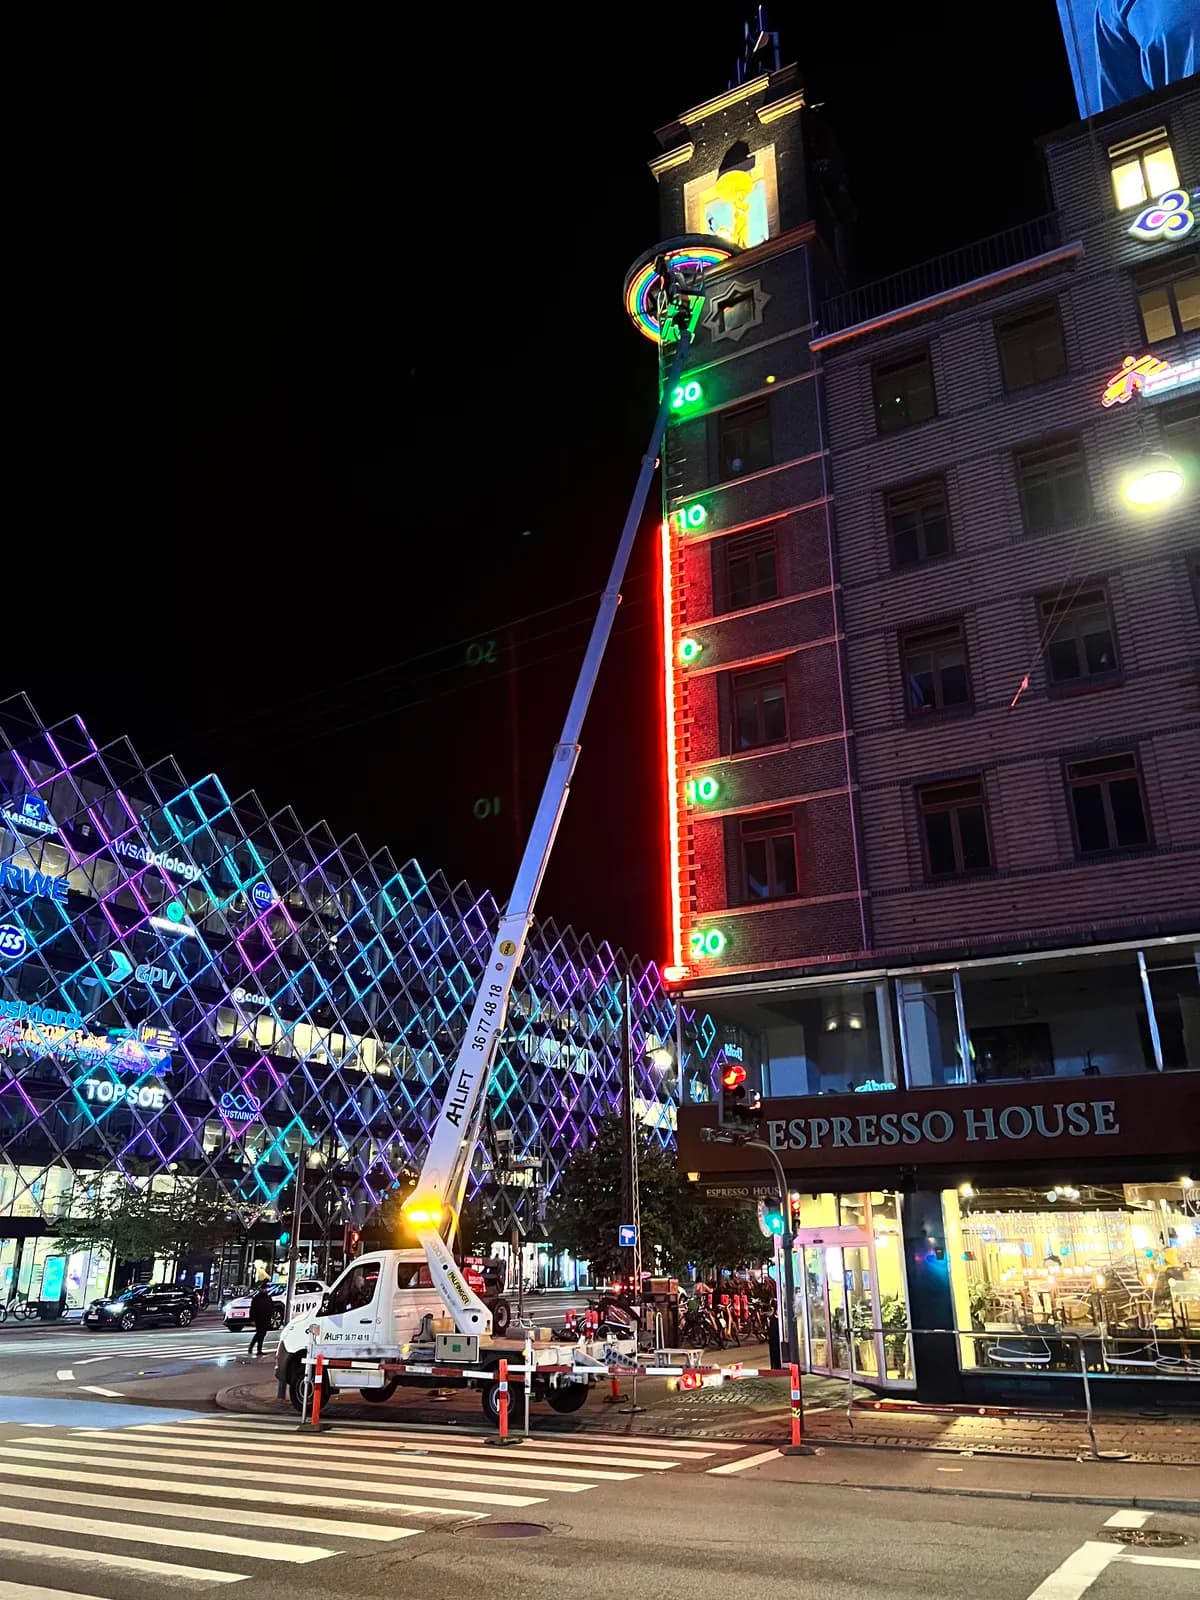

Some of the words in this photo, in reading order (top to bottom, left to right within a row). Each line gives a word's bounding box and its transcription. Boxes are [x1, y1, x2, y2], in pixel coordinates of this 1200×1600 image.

[673, 381, 702, 408] 20
[679, 504, 706, 529] 10
[679, 638, 699, 663] 0
[686, 777, 720, 803] 10
[0, 862, 72, 904] RWE
[690, 928, 726, 956] 20
[135, 964, 178, 989] GPV
[489, 984, 502, 998] 18
[484, 1001, 497, 1017] 48
[477, 1018, 491, 1034] 77
[472, 1036, 486, 1052] 36
[85, 1078, 167, 1110] TOPSOE
[768, 1108, 954, 1151] ESPRESSO
[964, 1100, 1121, 1141] HOUSE
[706, 1187, 749, 1197] ESPRESSO
[753, 1186, 781, 1196] HOUS
